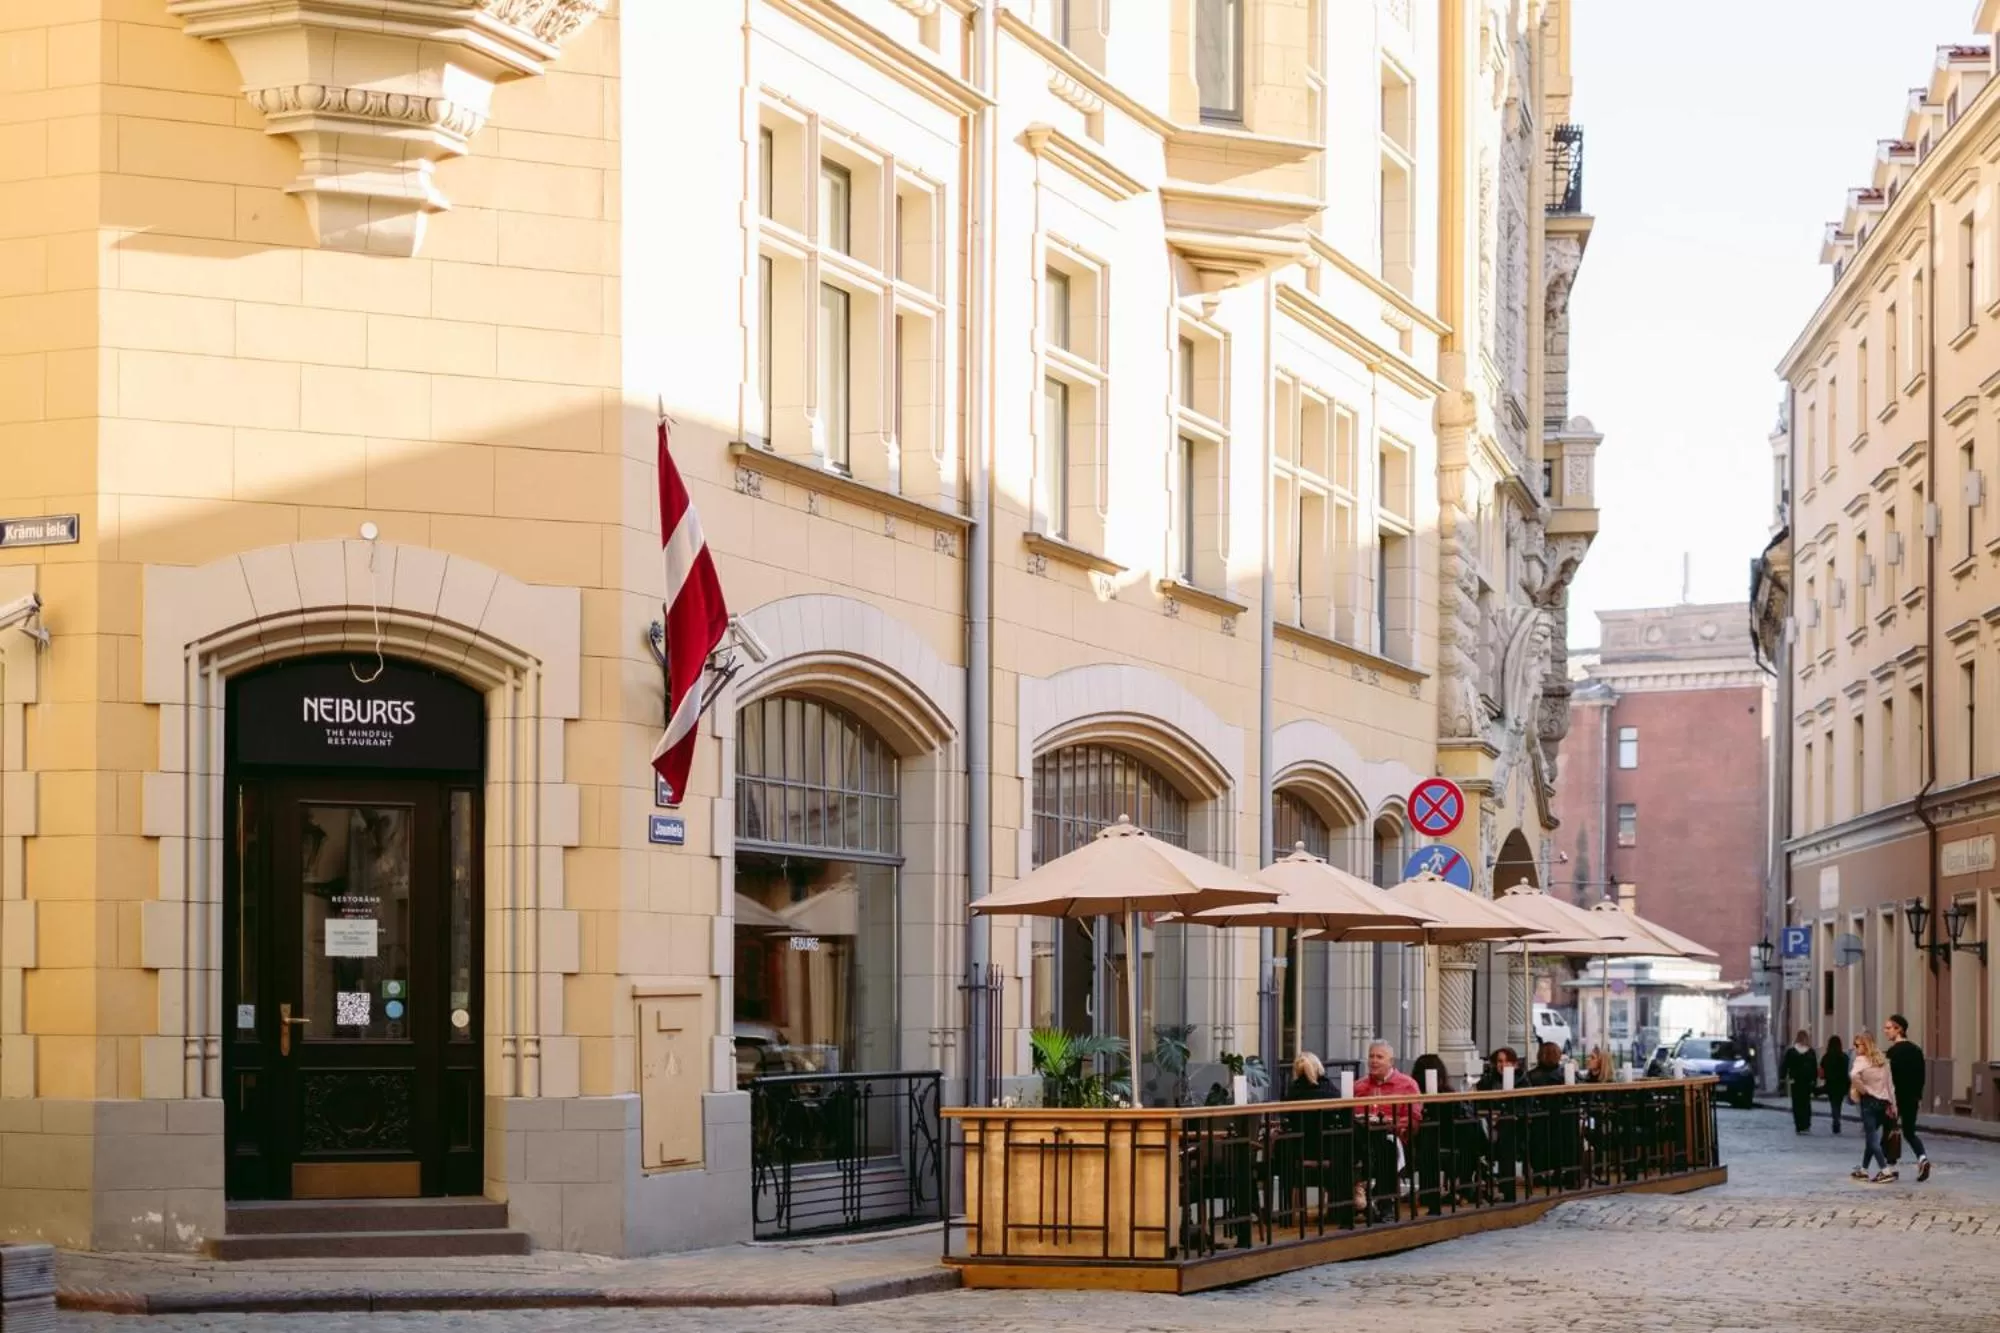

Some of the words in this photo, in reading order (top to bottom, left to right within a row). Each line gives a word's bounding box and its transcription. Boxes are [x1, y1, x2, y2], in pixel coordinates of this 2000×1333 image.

[5, 524, 43, 541] Krāmu
[47, 521, 66, 537] iela
[303, 697, 416, 724] NEIBURGS
[326, 729, 344, 737] THE
[349, 729, 394, 738] MINDFUL
[327, 737, 392, 746] RESTAURANT
[1788, 931, 1805, 952] P
